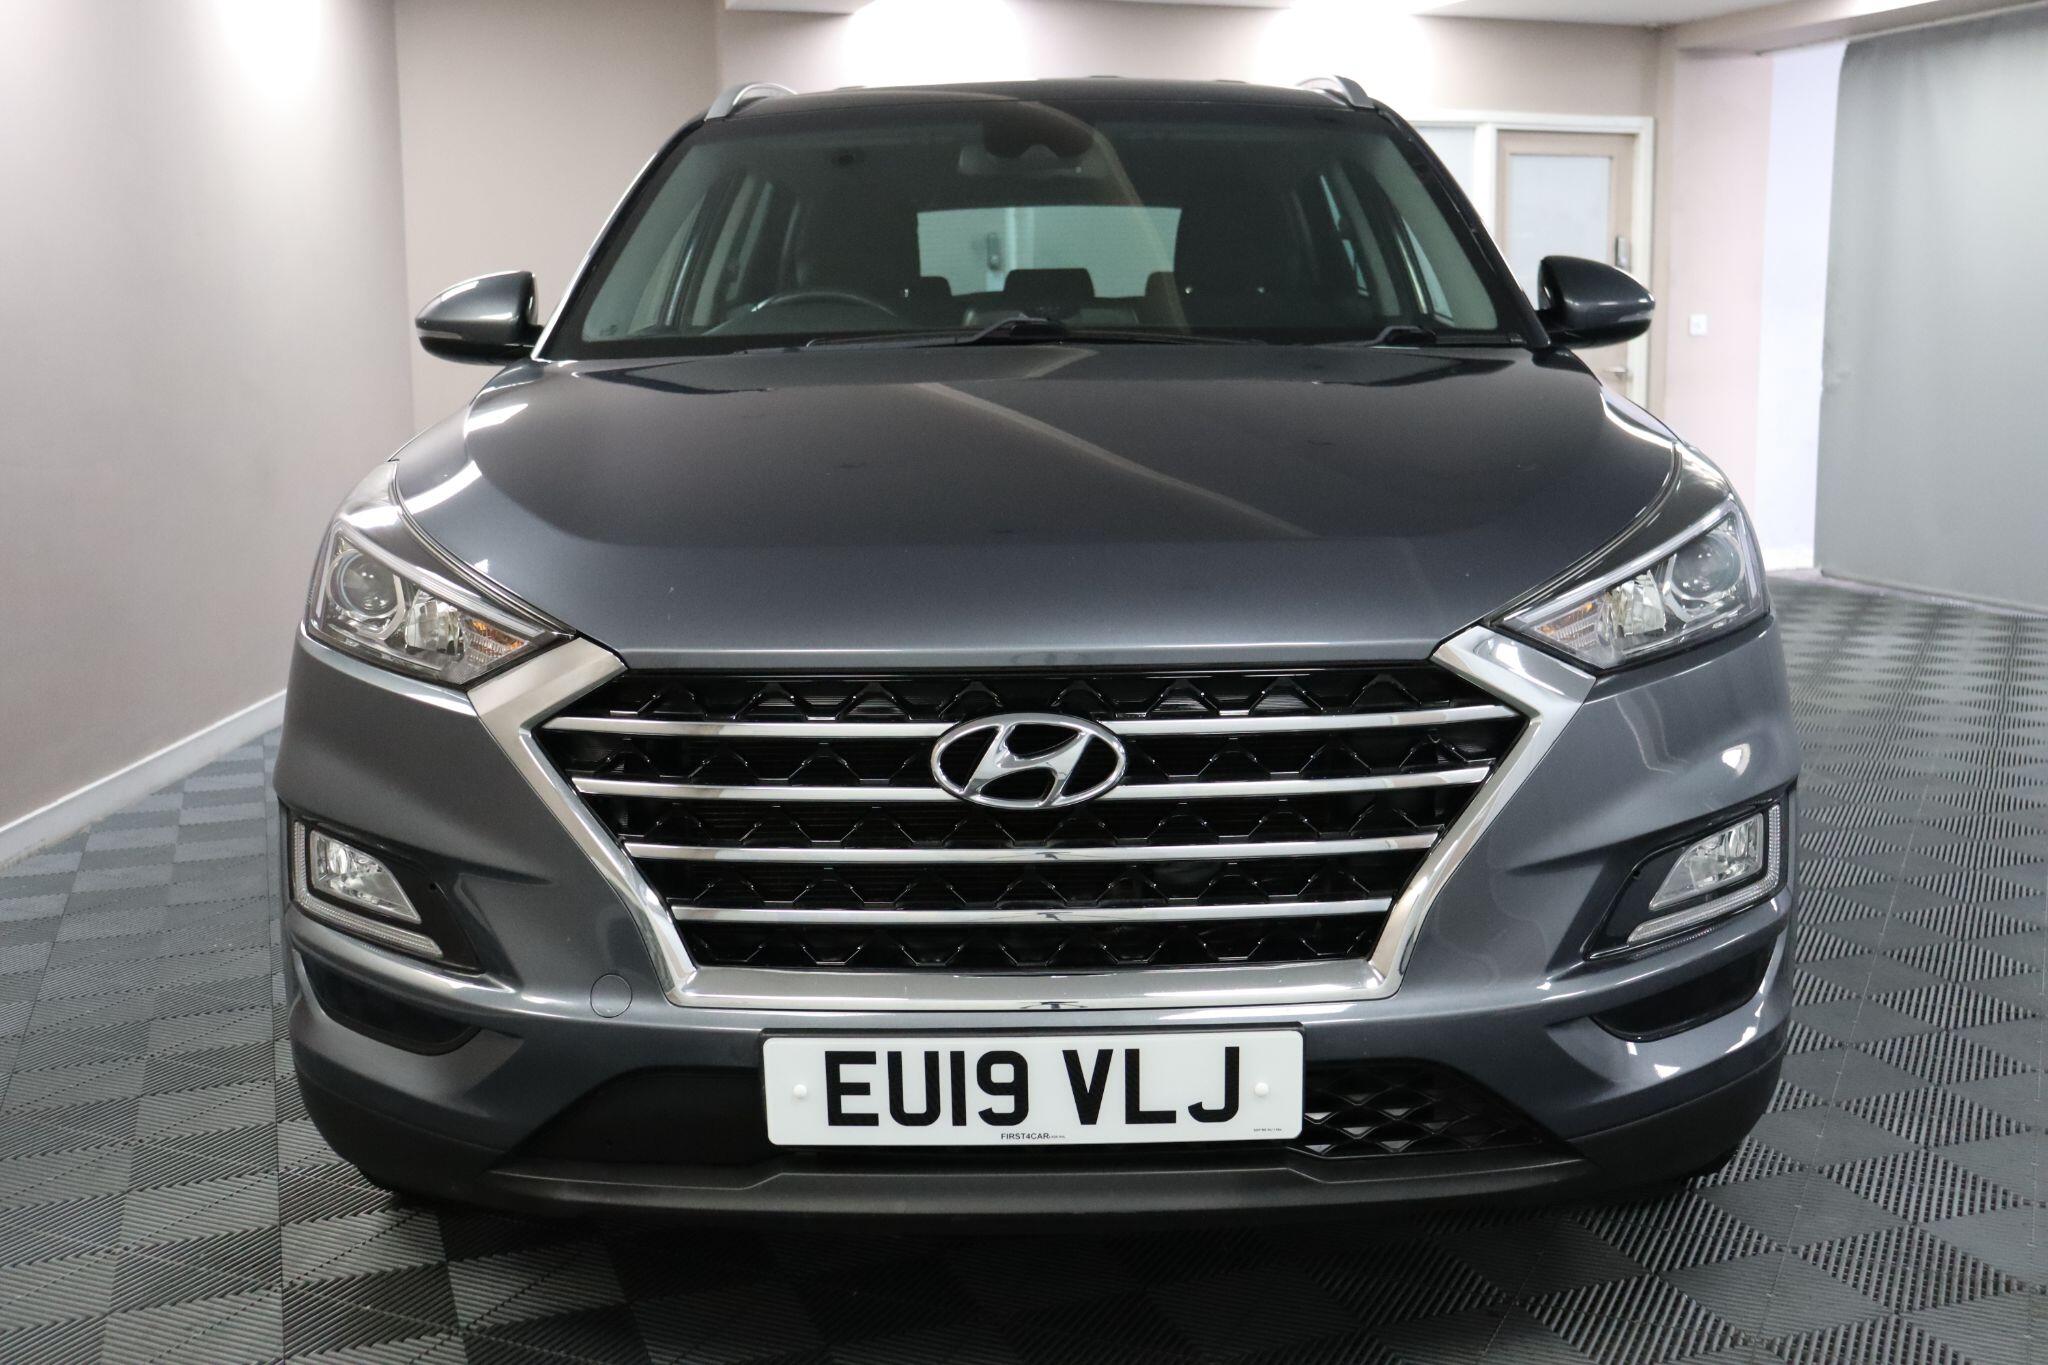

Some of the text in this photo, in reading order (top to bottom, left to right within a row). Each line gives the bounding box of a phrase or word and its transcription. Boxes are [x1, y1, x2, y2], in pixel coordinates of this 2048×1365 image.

[824, 1046, 1240, 1127] EU19 VLJ
[1000, 1132, 1049, 1140] FIRST4CAR
